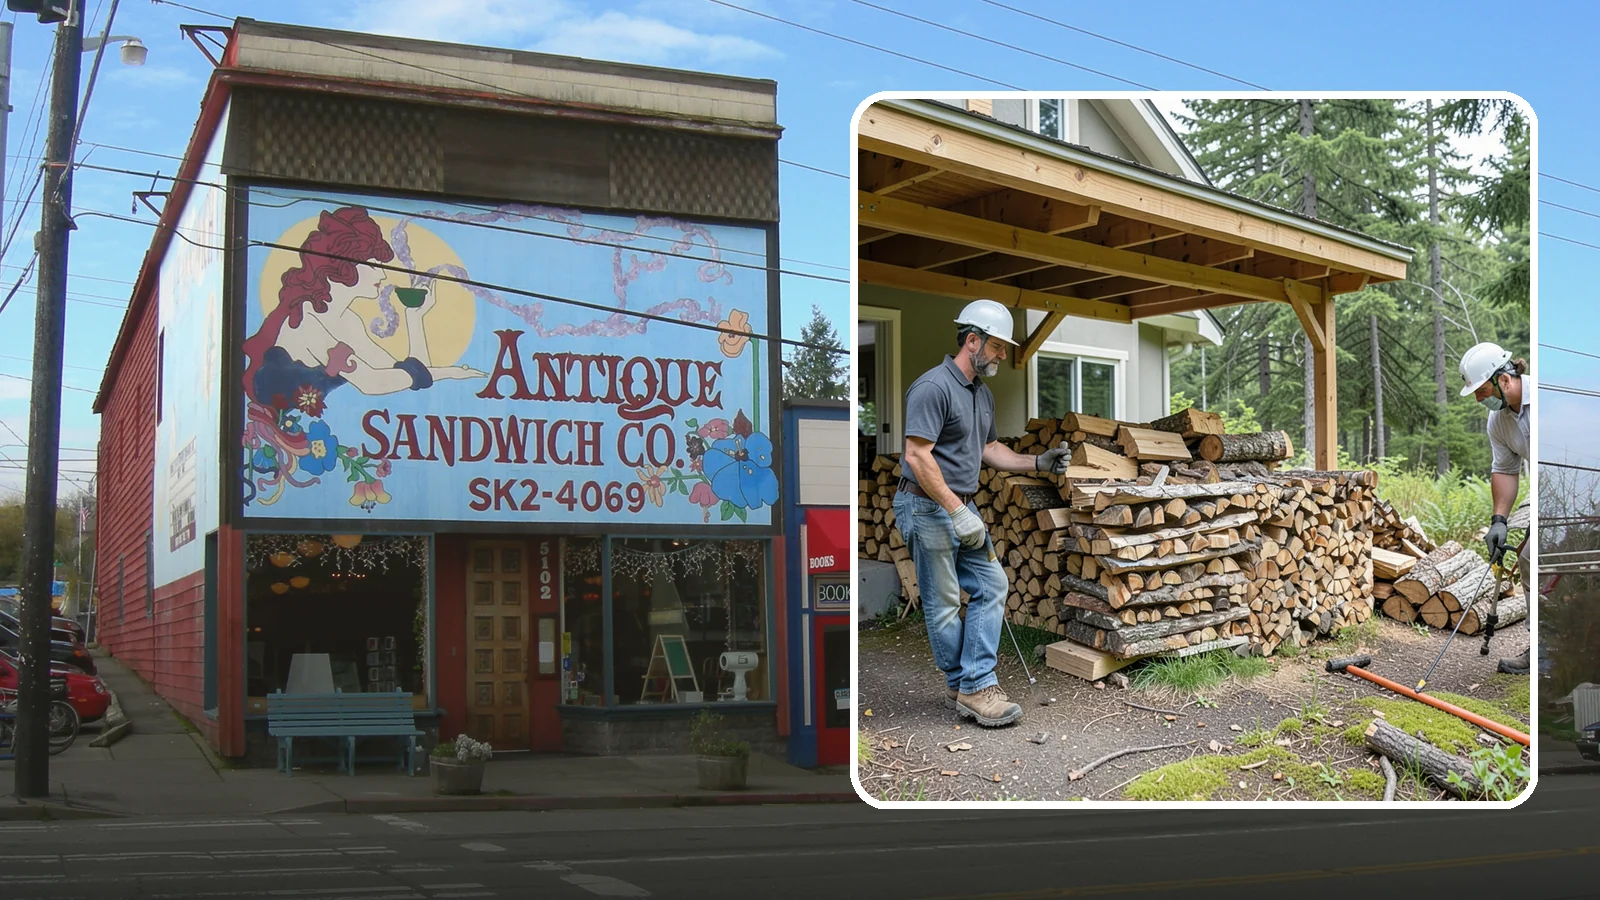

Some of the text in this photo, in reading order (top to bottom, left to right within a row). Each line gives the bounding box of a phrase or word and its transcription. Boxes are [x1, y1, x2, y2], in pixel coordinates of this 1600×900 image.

[475, 329, 724, 421] ANTIQUE
[361, 408, 685, 469] SANDWICH CO.
[468, 477, 646, 513] SK2-4069
[540, 542, 552, 600] 5102
[809, 555, 835, 569] BOOKS
